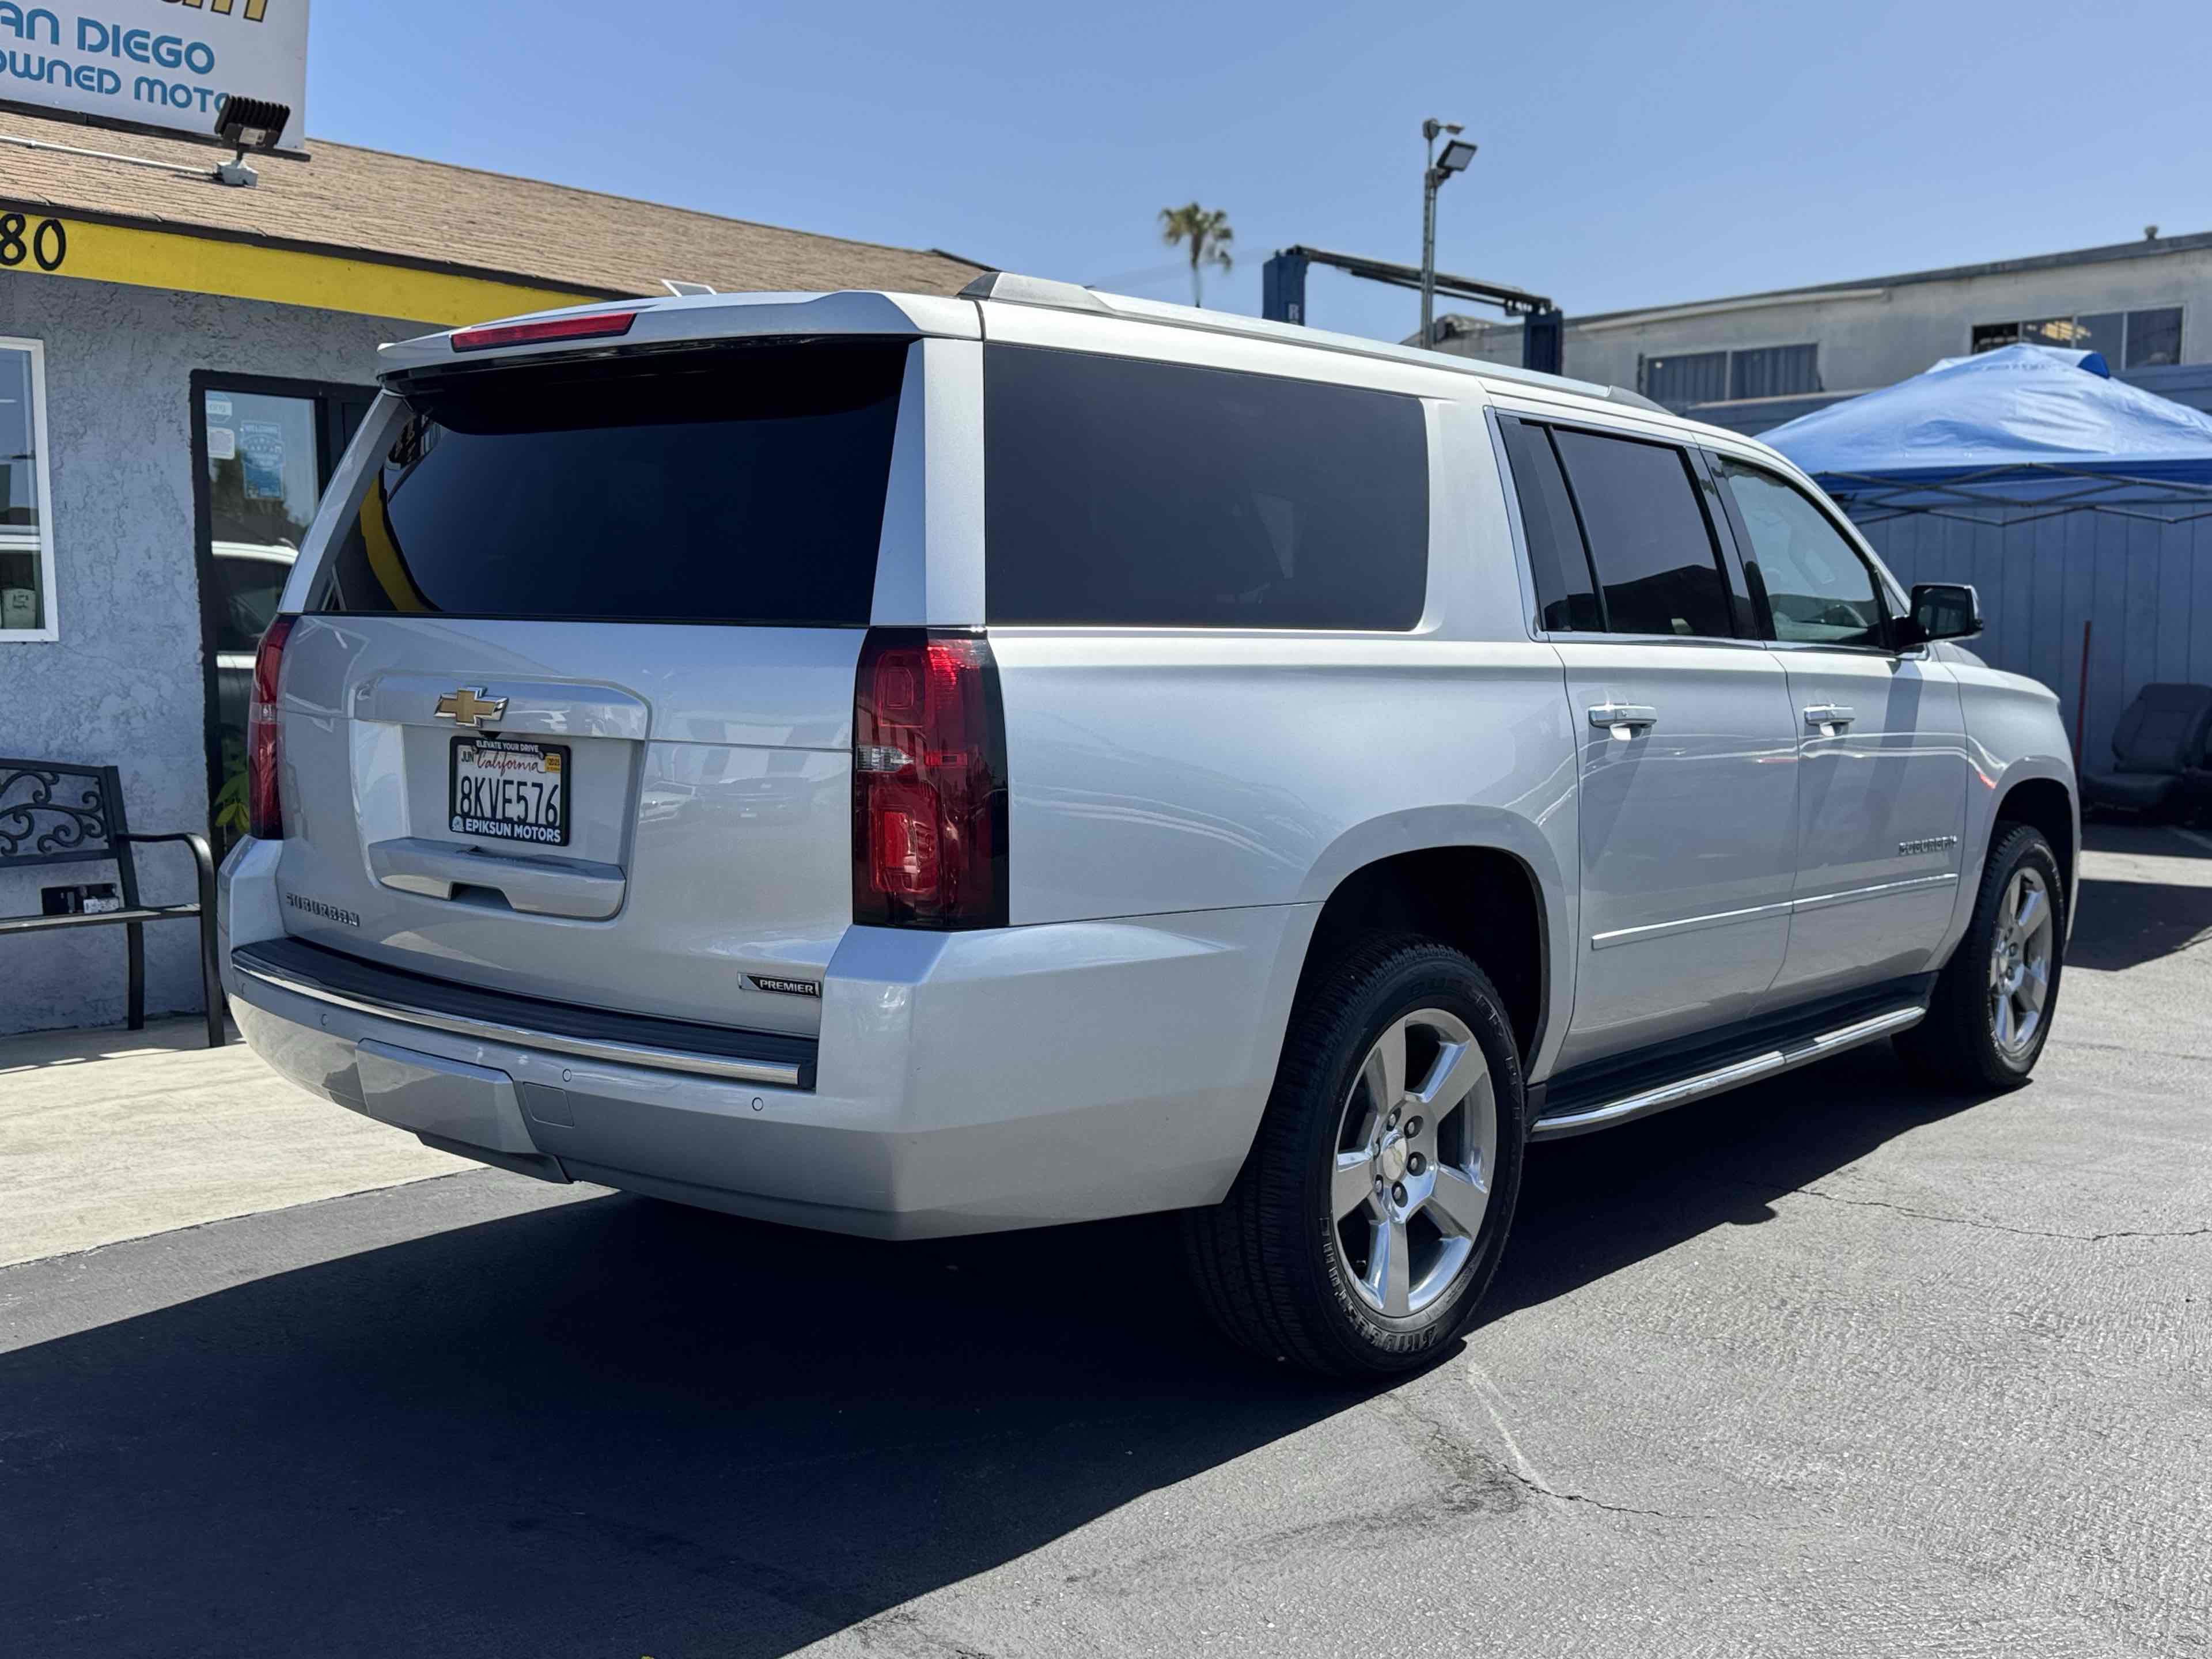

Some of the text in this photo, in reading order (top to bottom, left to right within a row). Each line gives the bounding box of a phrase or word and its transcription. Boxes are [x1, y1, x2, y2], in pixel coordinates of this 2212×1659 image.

[77, 17, 215, 75] DIEGO
[0, 213, 66, 271] 80
[476, 740, 539, 753] ELEVATE YOUR DRIVE
[478, 749, 546, 777] California
[461, 775, 559, 827] 8KVE576
[465, 818, 561, 843] EPIKSUN MOTORS
[759, 979, 814, 994] PREMIER
